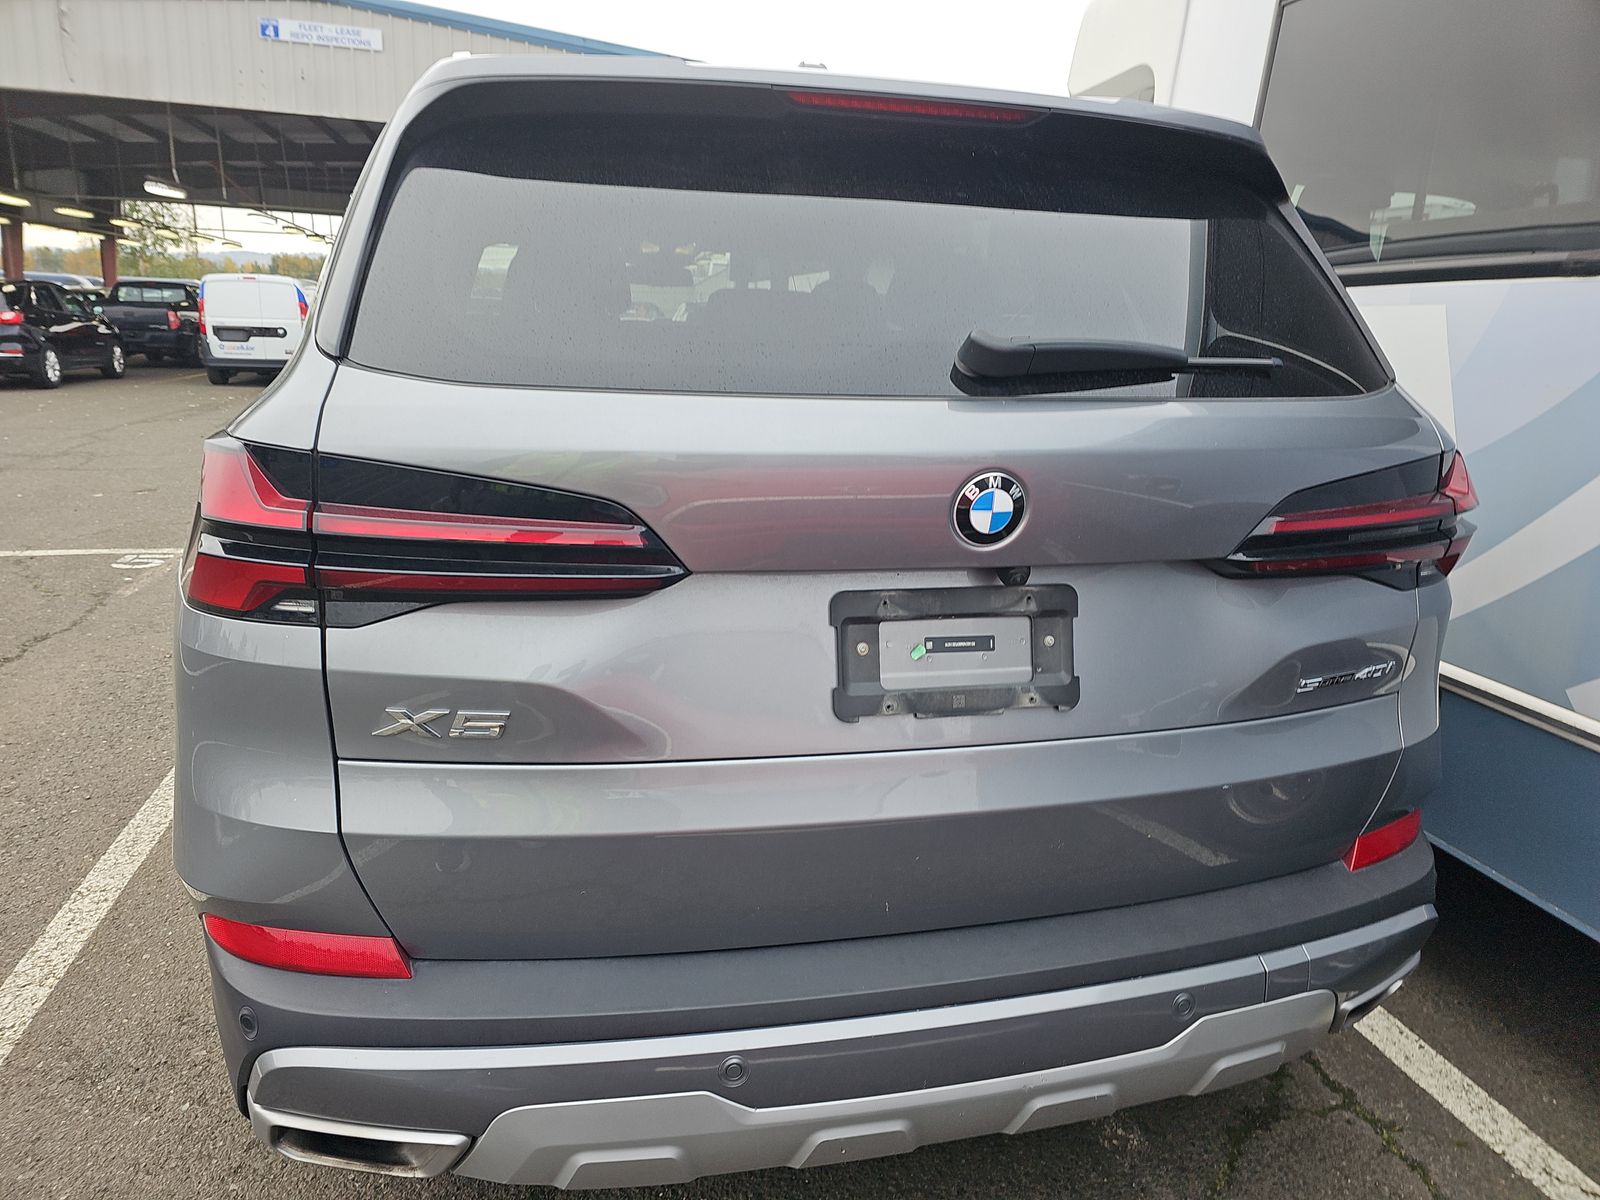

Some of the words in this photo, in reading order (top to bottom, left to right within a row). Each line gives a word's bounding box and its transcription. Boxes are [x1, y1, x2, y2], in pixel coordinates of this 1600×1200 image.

[264, 24, 275, 38] 4
[299, 21, 323, 33] FLEET
[335, 25, 362, 36] LEASE
[316, 34, 372, 47] INSPECTIONS
[964, 476, 1022, 501] BMW
[371, 706, 512, 740] X5
